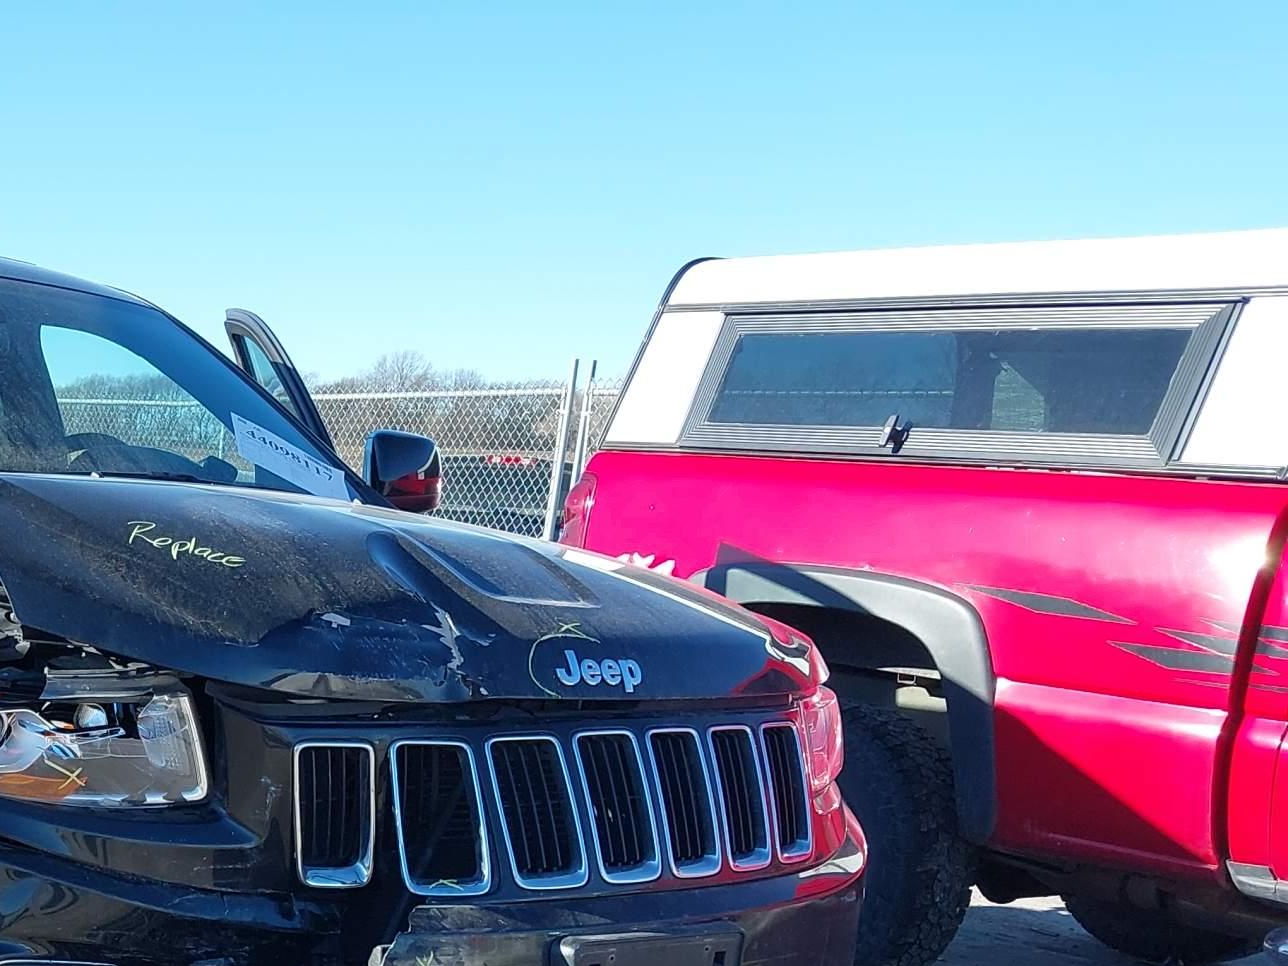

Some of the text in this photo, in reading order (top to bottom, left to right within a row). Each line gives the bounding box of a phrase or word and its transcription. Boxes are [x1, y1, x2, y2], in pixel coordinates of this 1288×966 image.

[246, 430, 333, 481] 44098117
[127, 521, 246, 567] Replace
[555, 649, 643, 693] Jeep
